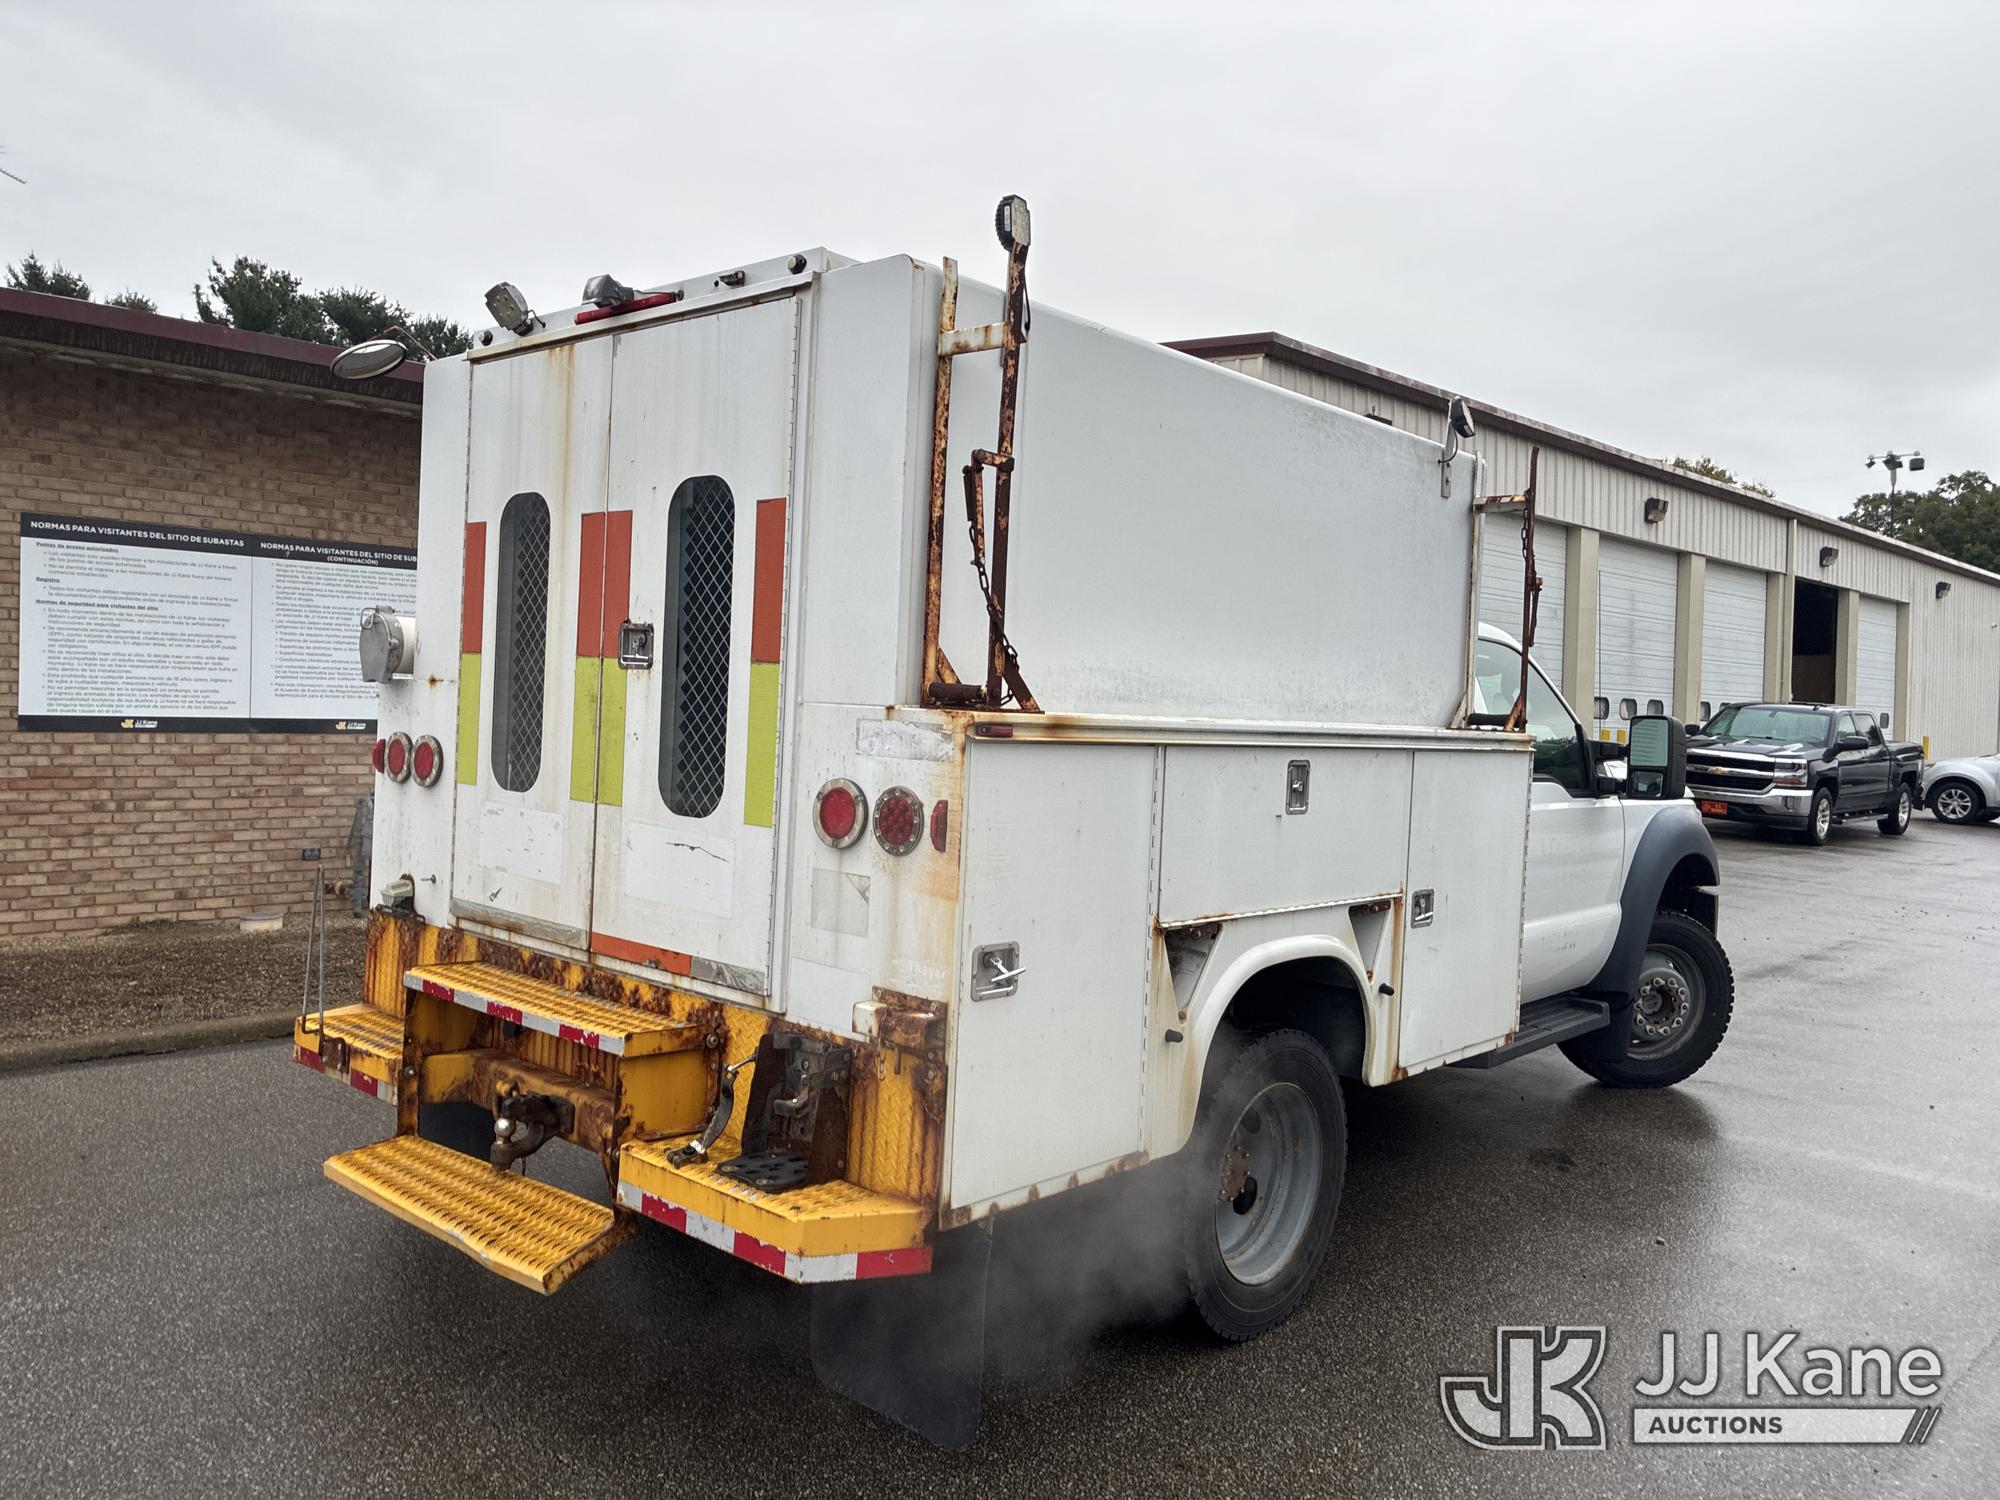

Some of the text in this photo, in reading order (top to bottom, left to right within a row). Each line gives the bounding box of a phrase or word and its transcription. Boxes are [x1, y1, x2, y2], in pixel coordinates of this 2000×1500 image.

[30, 520, 70, 530] NORMAS
[72, 524, 95, 533] PARA
[98, 527, 147, 538] VISITANTES
[203, 537, 243, 546] SUBASTAS
[261, 542, 294, 551] NORMAS
[317, 547, 358, 557] VISITANTES
[327, 556, 378, 565] (CONTINUACIÓN)
